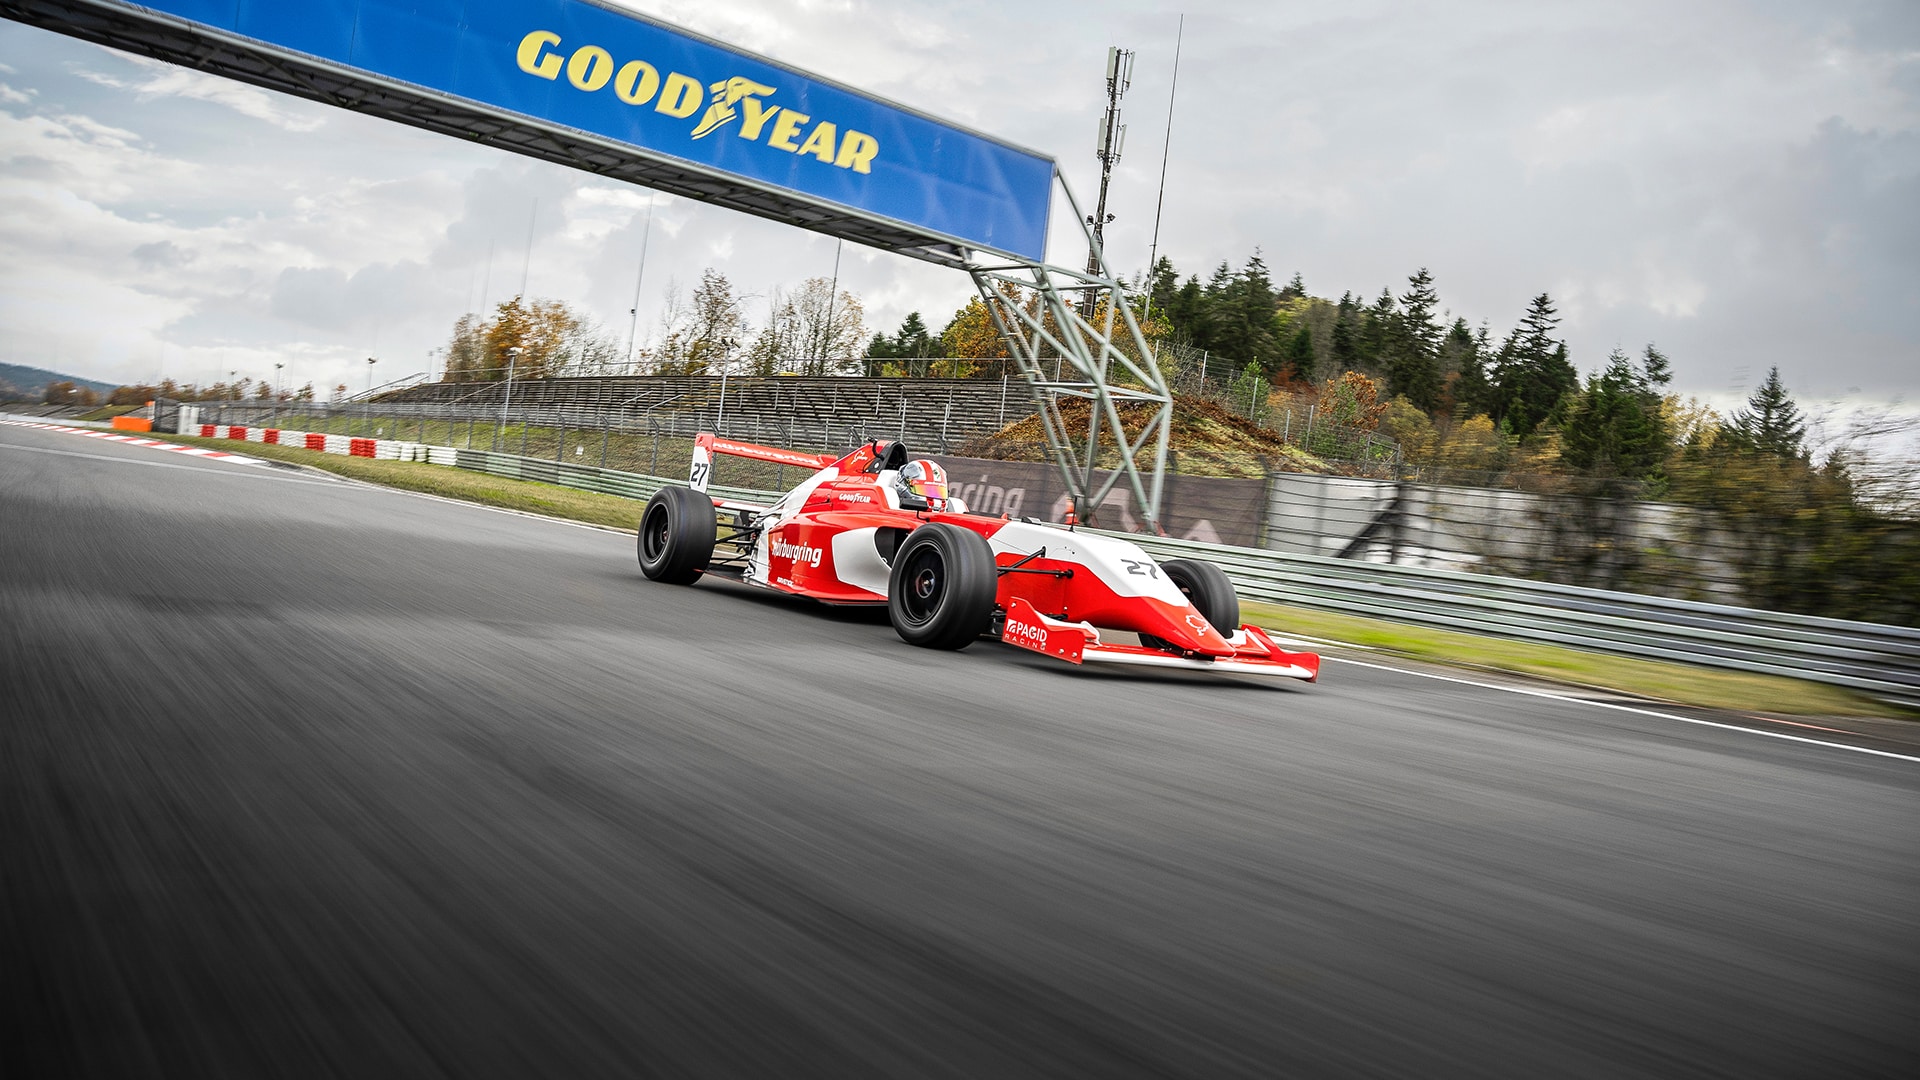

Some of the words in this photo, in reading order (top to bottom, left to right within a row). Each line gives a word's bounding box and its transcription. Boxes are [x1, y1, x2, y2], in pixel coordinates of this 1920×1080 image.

[517, 30, 879, 174] GOODYEAR
[691, 463, 708, 486] 27
[1120, 559, 1158, 580] 27
[1004, 633, 1047, 651] RACING
[1016, 621, 1048, 642] PAGID
